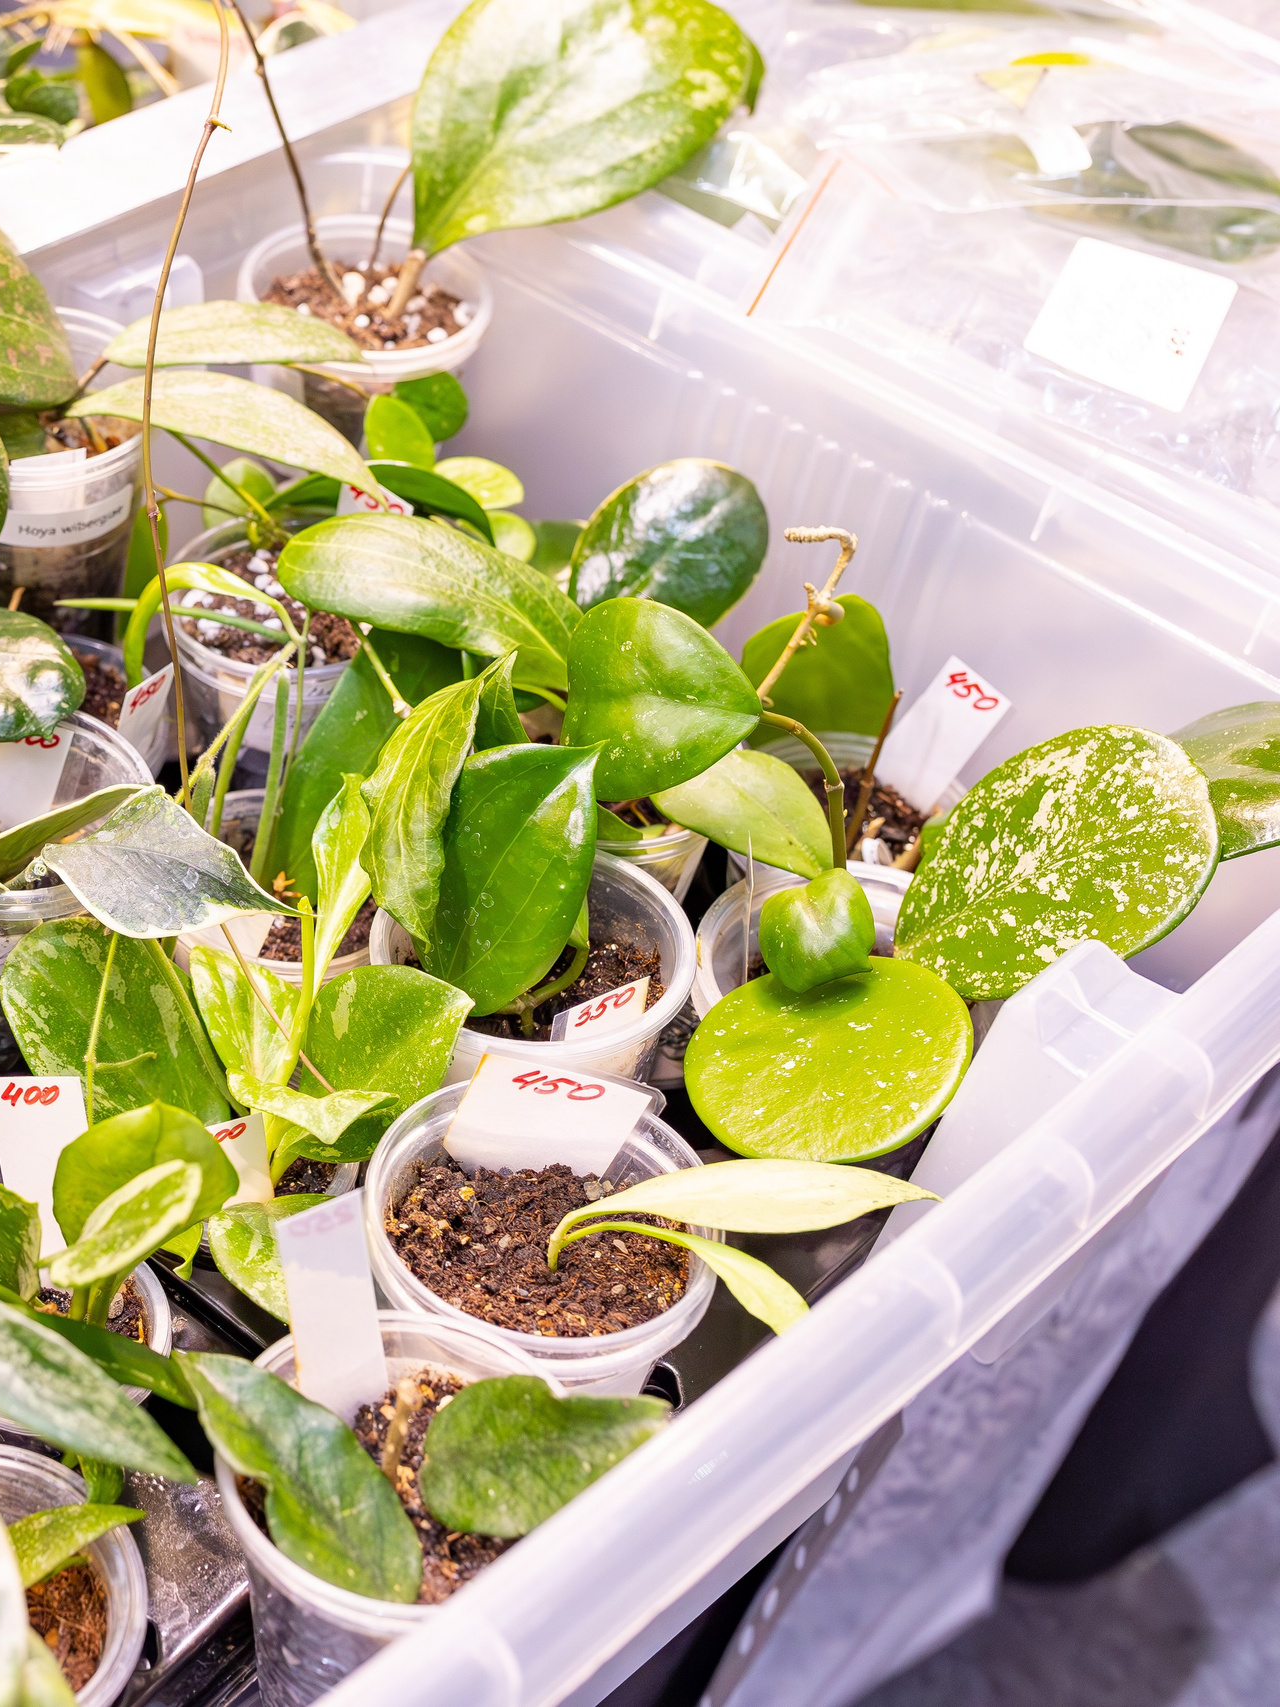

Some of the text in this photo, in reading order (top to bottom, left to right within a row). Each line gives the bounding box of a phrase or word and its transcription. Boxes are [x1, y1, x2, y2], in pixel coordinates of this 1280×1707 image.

[18, 525, 56, 538] Hoya
[130, 674, 166, 715] 450
[945, 672, 998, 710] 450
[574, 986, 636, 1027] 350
[1, 1082, 60, 1107] 400
[511, 1070, 605, 1101] 450
